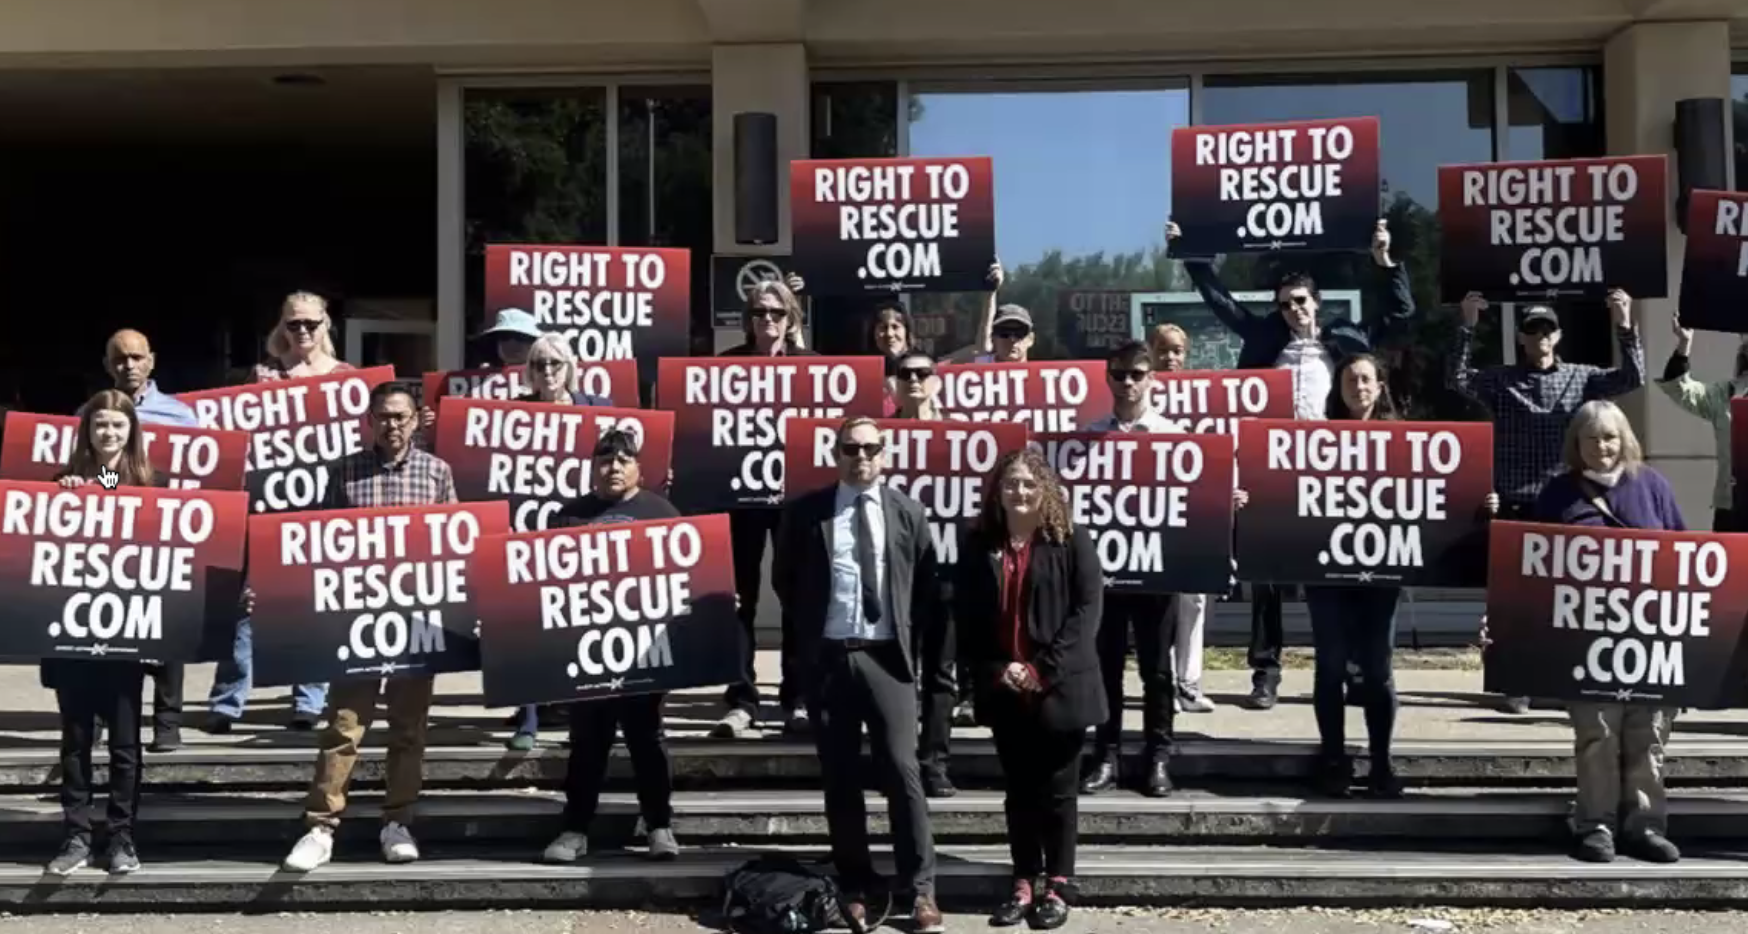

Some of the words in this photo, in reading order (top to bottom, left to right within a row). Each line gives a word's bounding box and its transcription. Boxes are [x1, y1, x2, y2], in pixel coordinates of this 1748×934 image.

[1196, 130, 1297, 165] RIGHT
[1308, 125, 1353, 160] TO
[815, 165, 914, 202] RIGHT
[926, 164, 969, 199] TO
[1220, 164, 1342, 200] RESCUE
[1463, 167, 1575, 206] RIGHT
[1587, 163, 1638, 201] TO
[840, 204, 959, 240] RESCUE
[1236, 201, 1323, 238] .COM
[1491, 205, 1624, 245] RESCUE
[510, 251, 611, 287] RIGHT
[622, 253, 665, 289] TO
[858, 243, 941, 278] .COM
[1509, 246, 1603, 285] .COM
[534, 290, 653, 326] RESCUE
[563, 328, 633, 361] COM
[196, 385, 308, 431] RIGHT
[320, 377, 370, 418] TO
[449, 372, 522, 400] RIG
[686, 365, 797, 404] RIGHT
[808, 364, 857, 404] TO
[1040, 367, 1088, 405] TO
[1149, 379, 1211, 414] GHT
[1222, 377, 1268, 413] TO
[245, 420, 363, 471] ESCUE
[465, 407, 582, 453] RIGHT
[713, 408, 844, 447] RESC
[168, 433, 219, 476] TO
[730, 450, 785, 490] .CO
[814, 427, 933, 470] RHT
[946, 429, 998, 473] TO
[1152, 441, 1203, 482] TO
[1268, 429, 1392, 471] RIGHT
[1406, 431, 1461, 474] TO
[488, 453, 592, 498] RESC
[877, 475, 982, 518] CUE
[3, 490, 142, 540] RIGHT
[157, 498, 214, 543] TO
[1059, 485, 1188, 527] ESCUE
[1298, 476, 1446, 520] RESCUE
[281, 515, 410, 565] RIGHT
[424, 510, 479, 555] TO
[505, 529, 632, 584] RIGHT
[645, 522, 702, 567] TO
[1089, 530, 1163, 572] OM
[1318, 523, 1423, 567] .COM
[30, 541, 195, 591] RESCUE
[1521, 532, 1659, 585] RIGHT
[1674, 541, 1728, 587] TO
[314, 560, 467, 612] RESCUE
[540, 572, 692, 630] RESCUE
[48, 592, 162, 639] .COM
[1552, 584, 1711, 637] RESCUE
[337, 609, 446, 661] .COM
[567, 623, 674, 678] .COM
[1572, 636, 1684, 685] .COM
